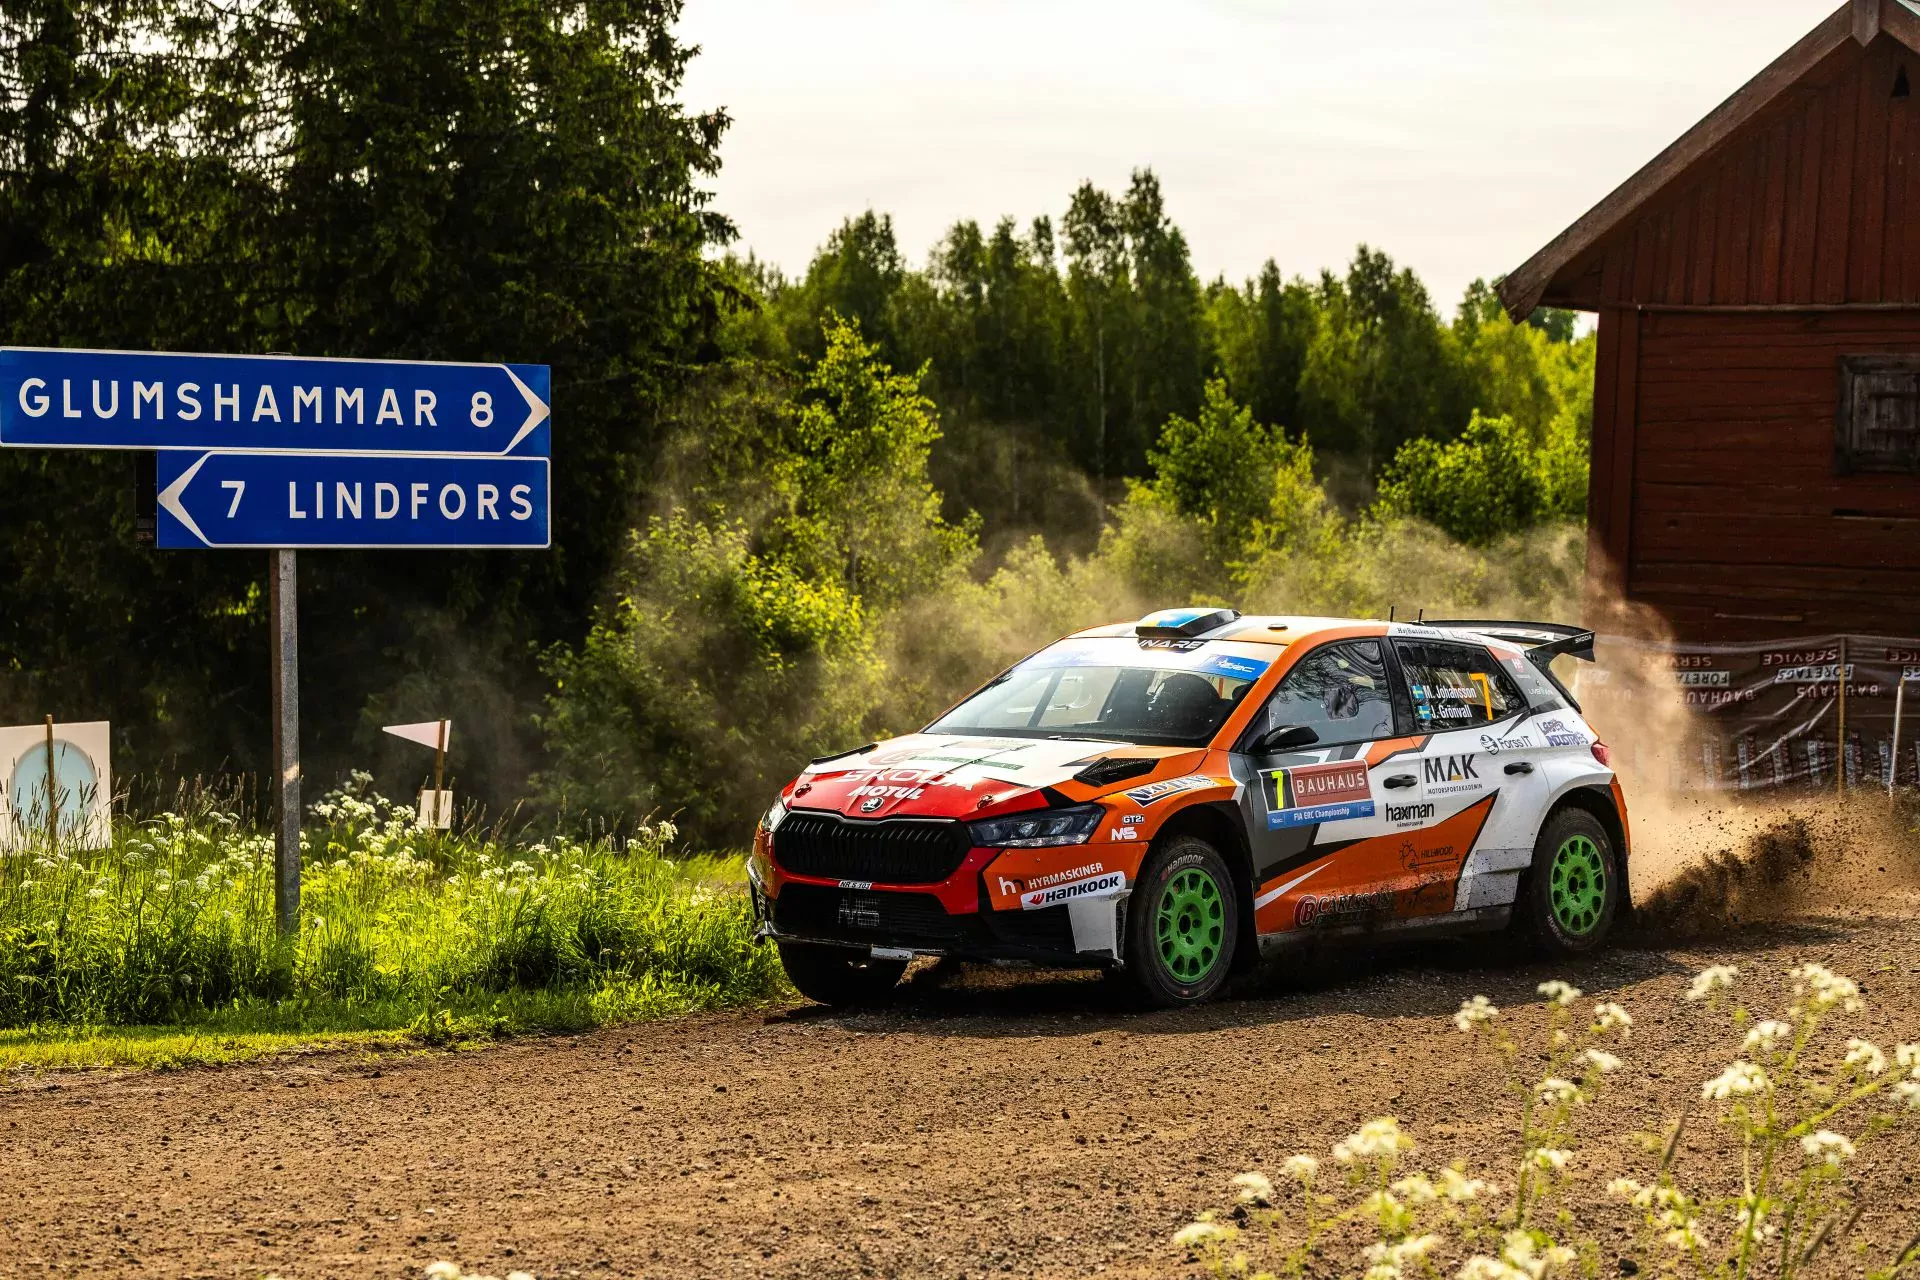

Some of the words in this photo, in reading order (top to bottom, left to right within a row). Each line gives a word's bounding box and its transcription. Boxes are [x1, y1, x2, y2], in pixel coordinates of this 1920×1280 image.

[19, 377, 438, 427] GLUMSHAMMAR
[470, 391, 494, 428] 8
[221, 481, 246, 519] 7
[289, 481, 534, 521] LINDFORS
[1762, 649, 1837, 666] SERVICE
[1423, 684, 1435, 699] M.
[1436, 685, 1477, 699] Johansson
[1470, 673, 1493, 720] 7
[1438, 704, 1473, 719] Grönvall
[1424, 753, 1480, 784] MAK
[848, 785, 925, 800] MOTUL
[1271, 770, 1285, 810] 7
[1297, 771, 1366, 794] BAUHAUS
[1314, 807, 1350, 819] Championship
[1385, 802, 1435, 822] haxman
[1028, 862, 1104, 890] HYRMASKINER
